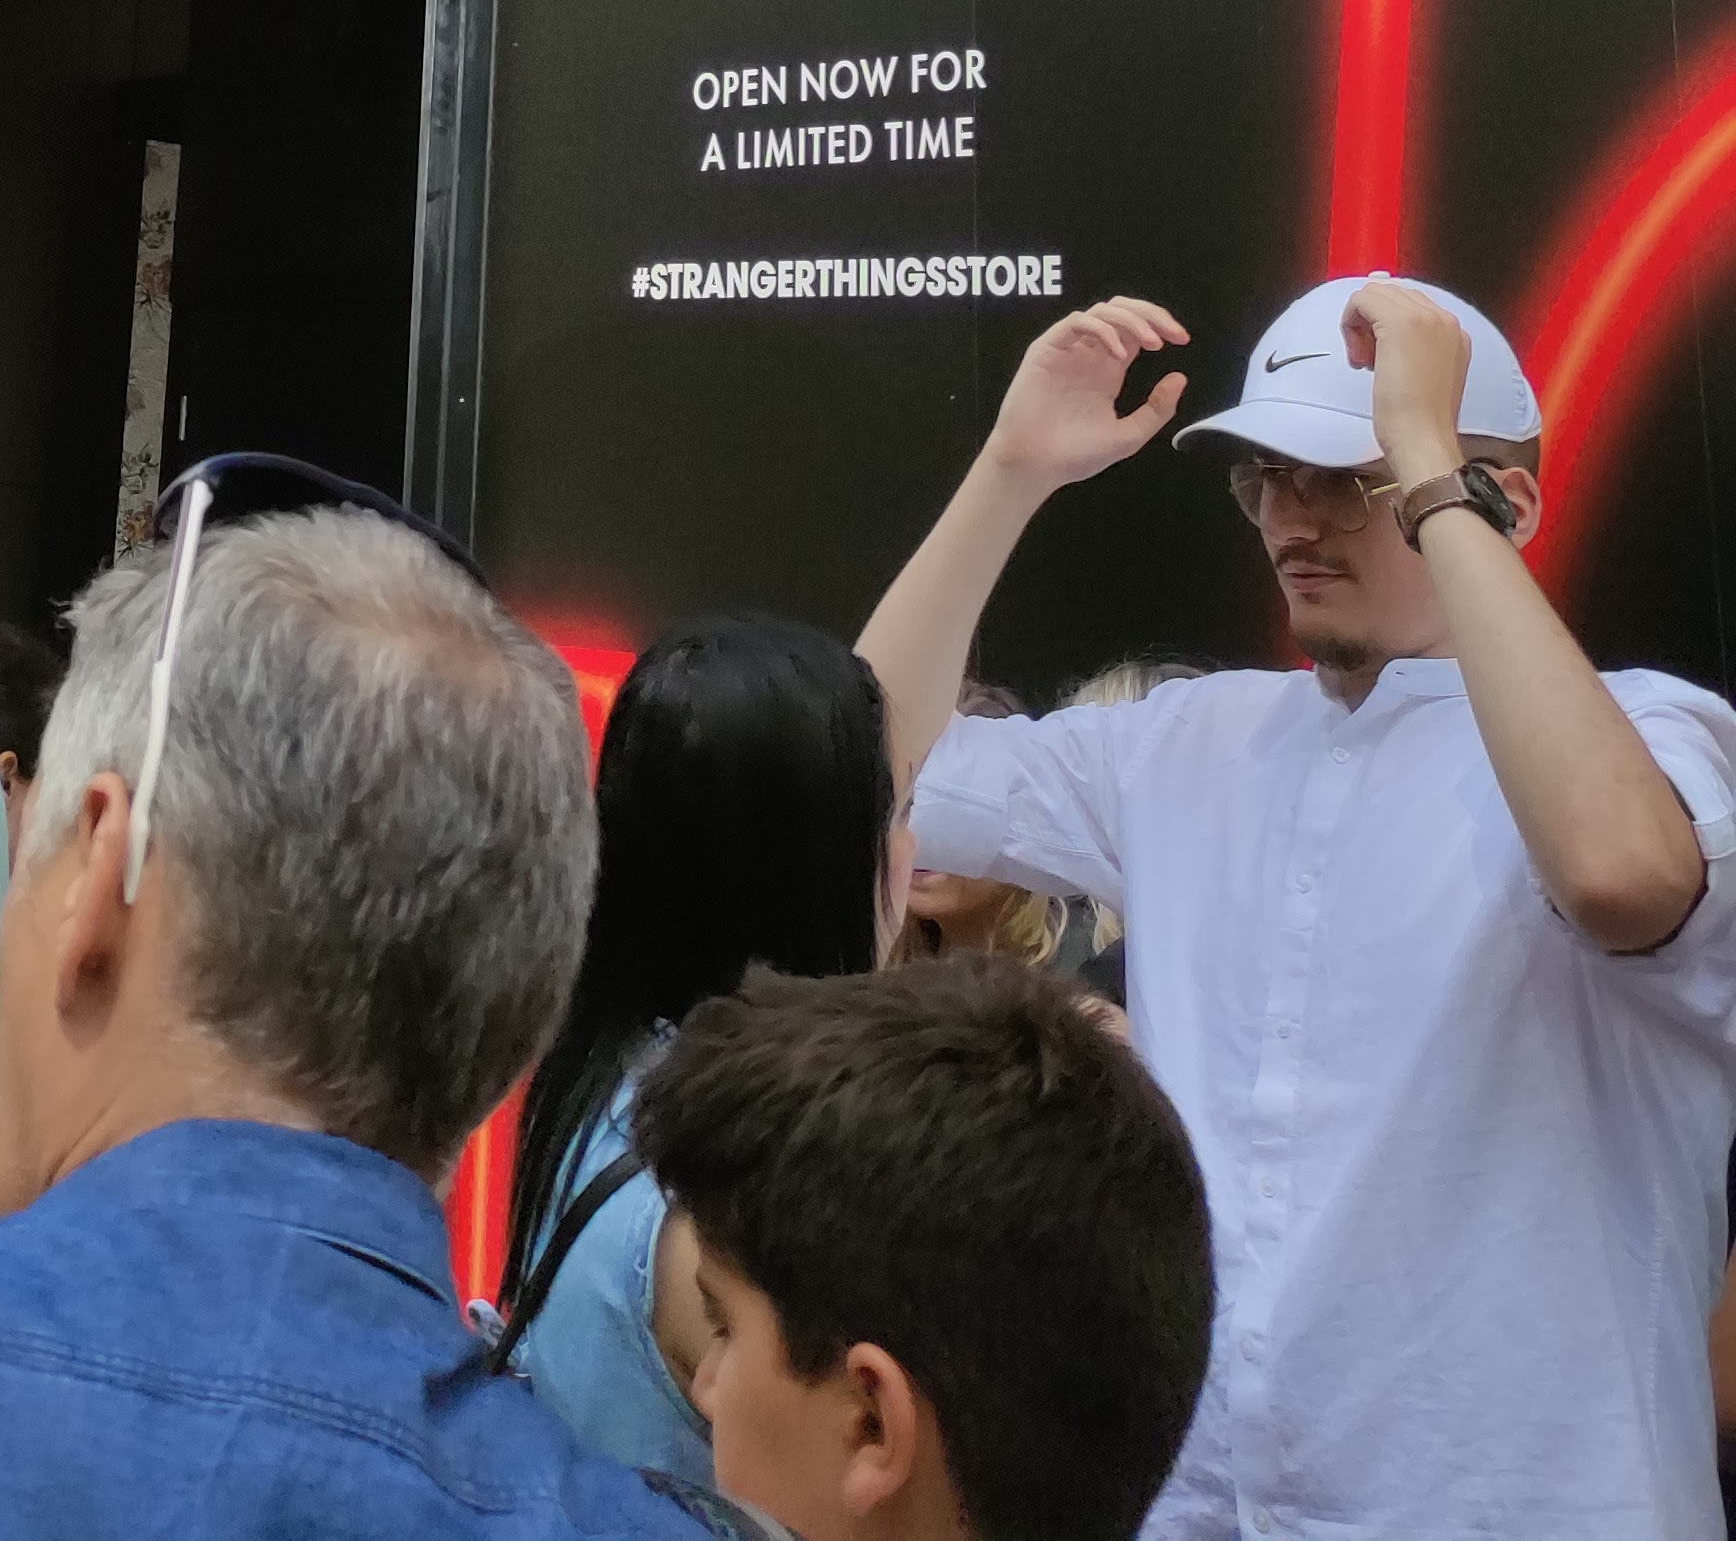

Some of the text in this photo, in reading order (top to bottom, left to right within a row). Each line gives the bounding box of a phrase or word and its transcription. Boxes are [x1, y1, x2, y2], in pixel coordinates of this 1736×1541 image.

[692, 49, 987, 111] OPEN NOW FOR
[700, 116, 975, 172] A LIMITED TIME
[631, 254, 1062, 301] #STRANGERTHINGSSTORE
